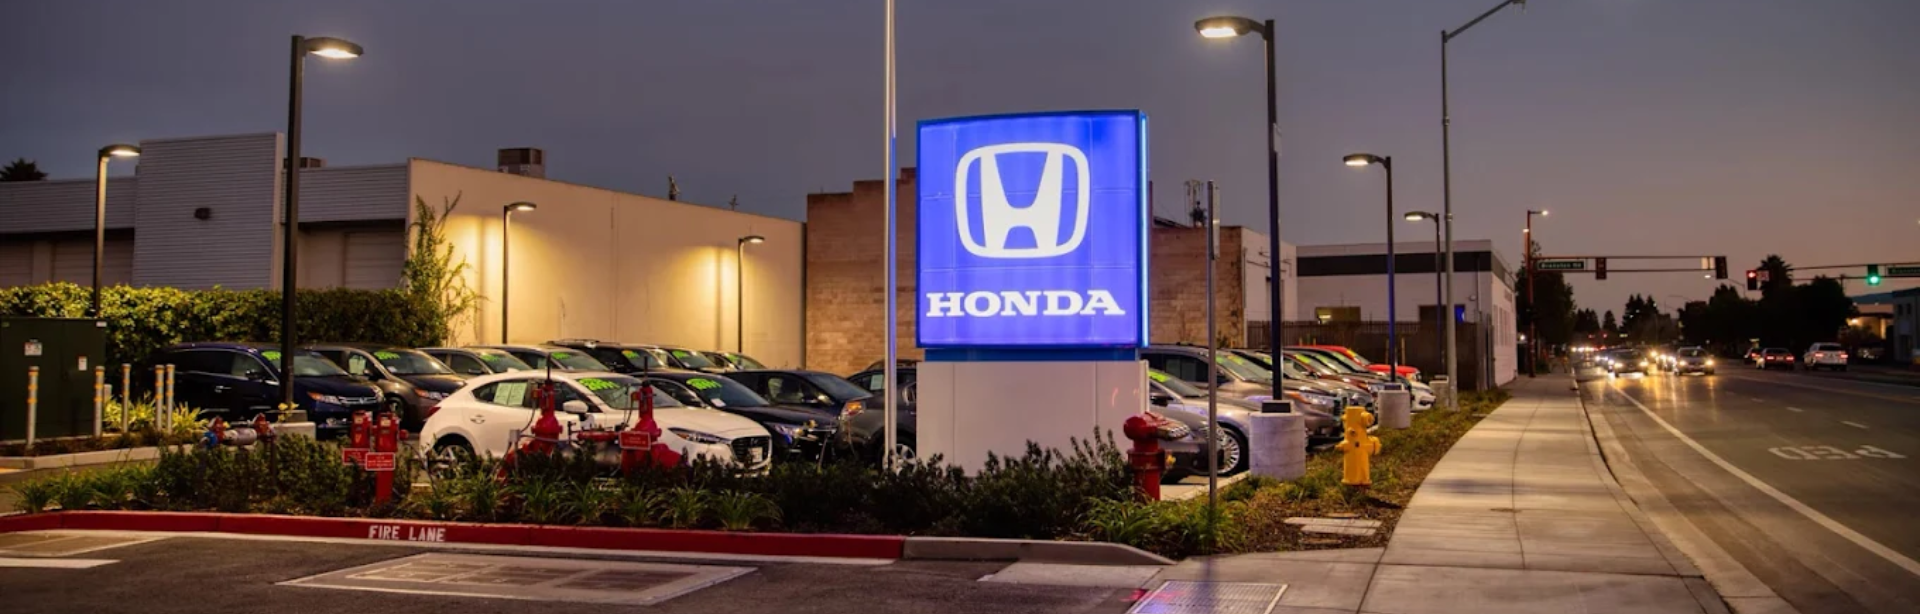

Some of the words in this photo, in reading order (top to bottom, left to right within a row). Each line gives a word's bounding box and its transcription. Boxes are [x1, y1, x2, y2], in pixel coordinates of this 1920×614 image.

[926, 290, 1126, 317] HONDA
[368, 525, 400, 540] FIRE
[408, 526, 446, 542] LANE
